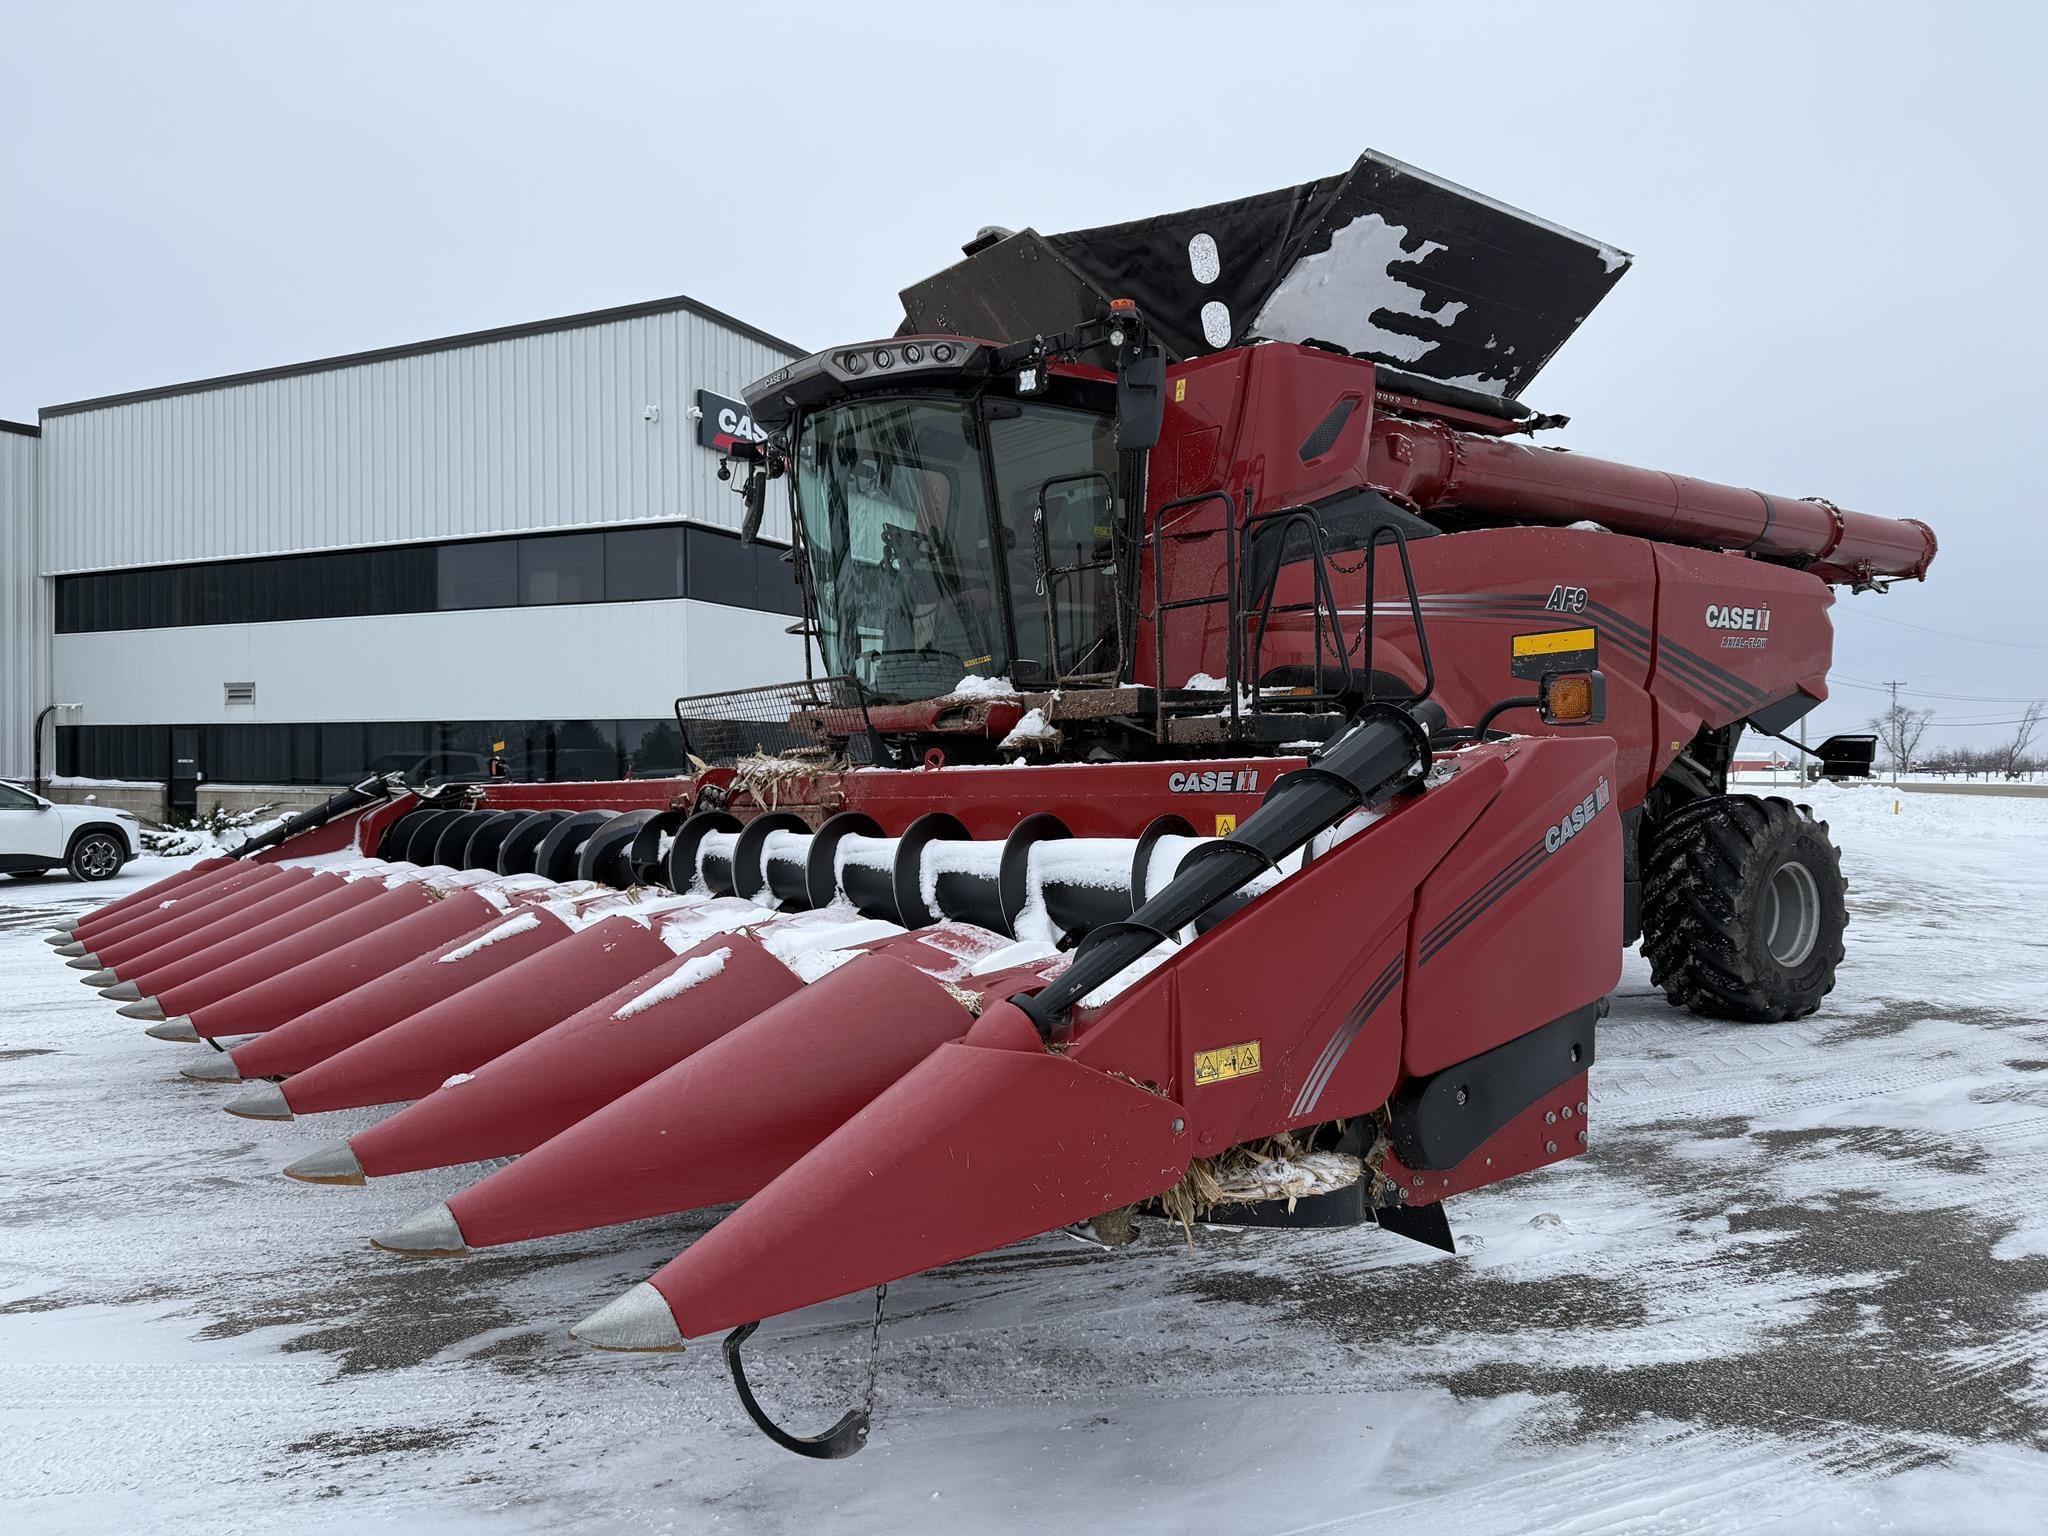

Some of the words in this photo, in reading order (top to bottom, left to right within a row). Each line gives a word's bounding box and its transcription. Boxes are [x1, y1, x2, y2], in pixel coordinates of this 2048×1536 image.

[765, 372, 781, 388] CASE
[1545, 585, 1588, 613] AF9
[1705, 604, 1755, 630] CASE
[1720, 636, 1768, 649] AXIAL-FLOW
[1168, 771, 1234, 792] CASE
[1545, 793, 1596, 853] CASE
